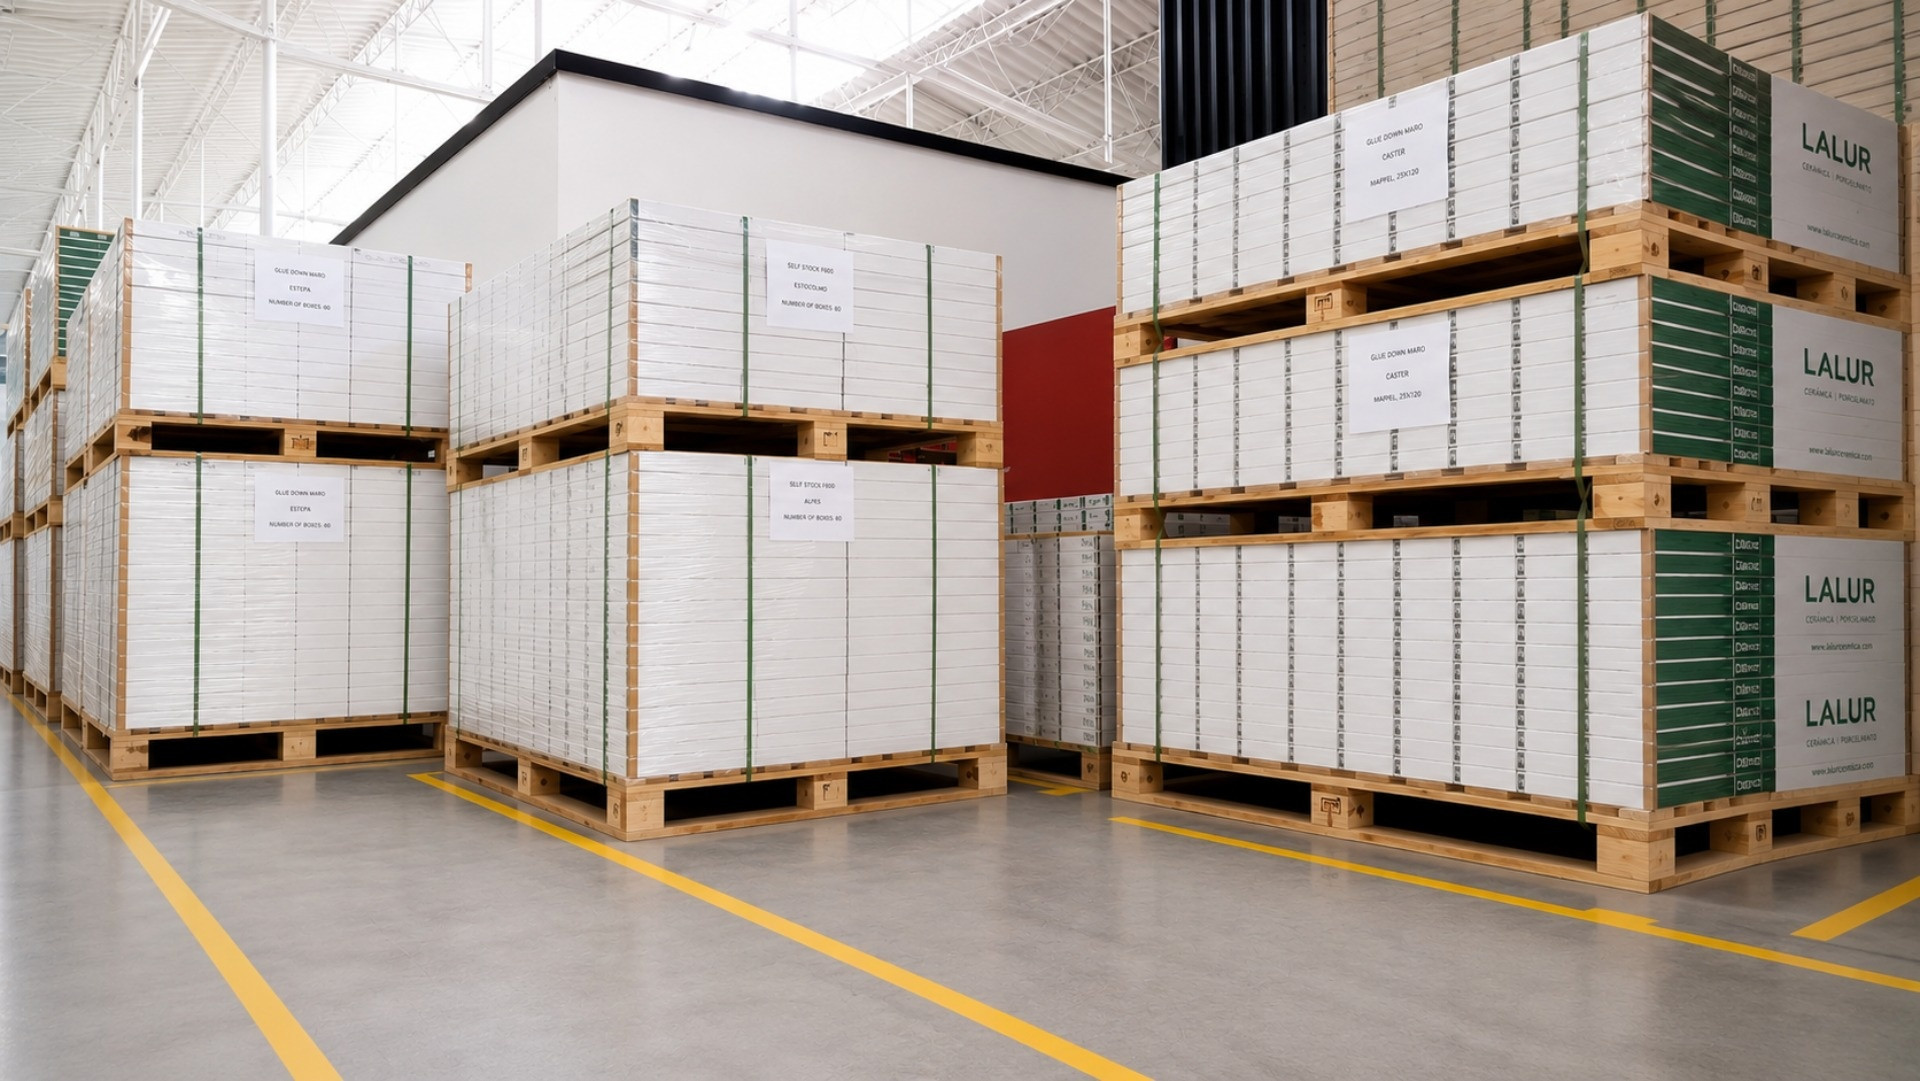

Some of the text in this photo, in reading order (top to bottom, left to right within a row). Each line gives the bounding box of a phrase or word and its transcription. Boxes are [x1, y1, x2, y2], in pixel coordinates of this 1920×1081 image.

[1383, 129, 1404, 142] DOWN
[1404, 122, 1424, 135] MARO
[1382, 147, 1406, 161] CASTER
[1802, 122, 1872, 175] LALUR
[802, 264, 819, 273] STOCK
[794, 282, 828, 292] ESTOCOLMO
[781, 299, 805, 308] NUMBER
[1387, 349, 1406, 359] DOWN
[1407, 345, 1426, 355] MARO
[1804, 347, 1874, 387] LALUR
[1385, 370, 1410, 380] CASTER
[804, 481, 821, 489] STOCK
[1805, 574, 1875, 603] LALUR
[1806, 696, 1876, 727] LALUR
